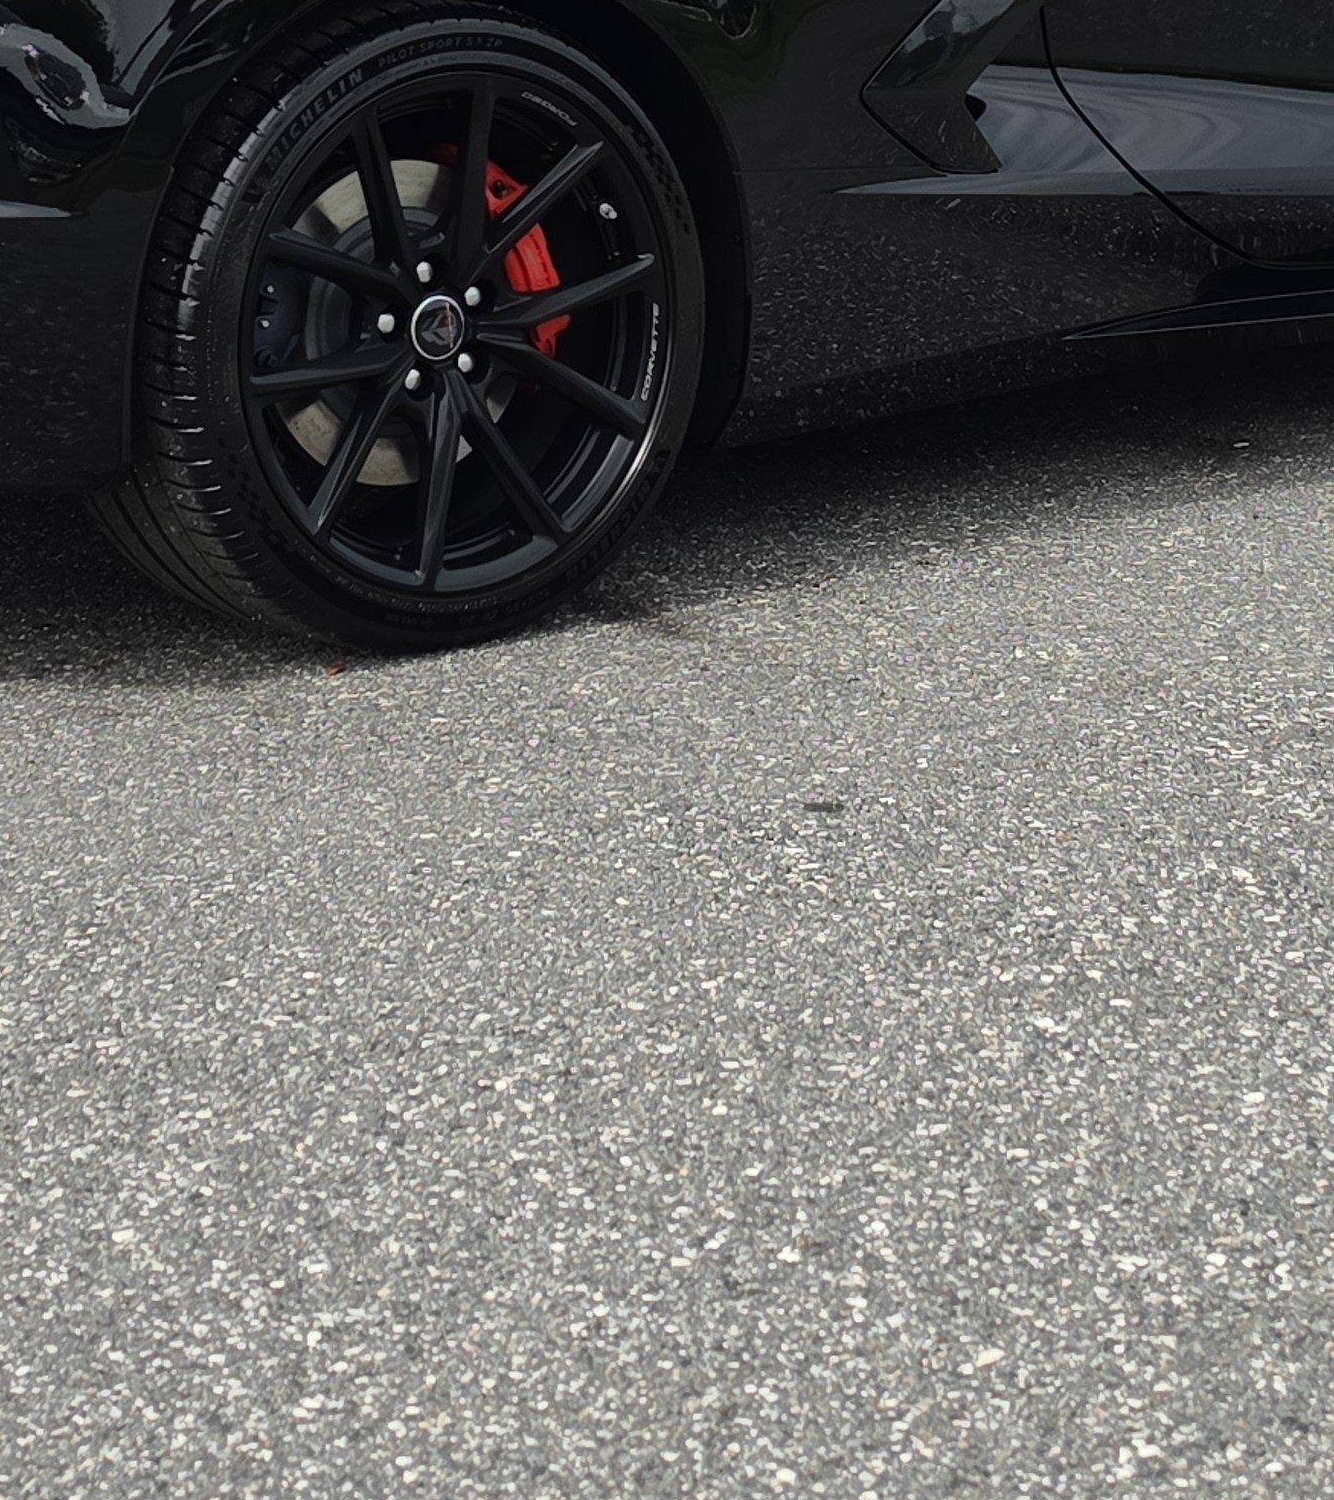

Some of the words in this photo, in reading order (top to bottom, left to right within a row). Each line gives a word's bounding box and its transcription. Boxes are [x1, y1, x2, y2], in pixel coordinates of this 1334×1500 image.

[378, 45, 415, 68] PILOT
[419, 36, 462, 53] SPORT
[265, 68, 364, 171] MICHELIN
[641, 303, 660, 401] CORVETTE
